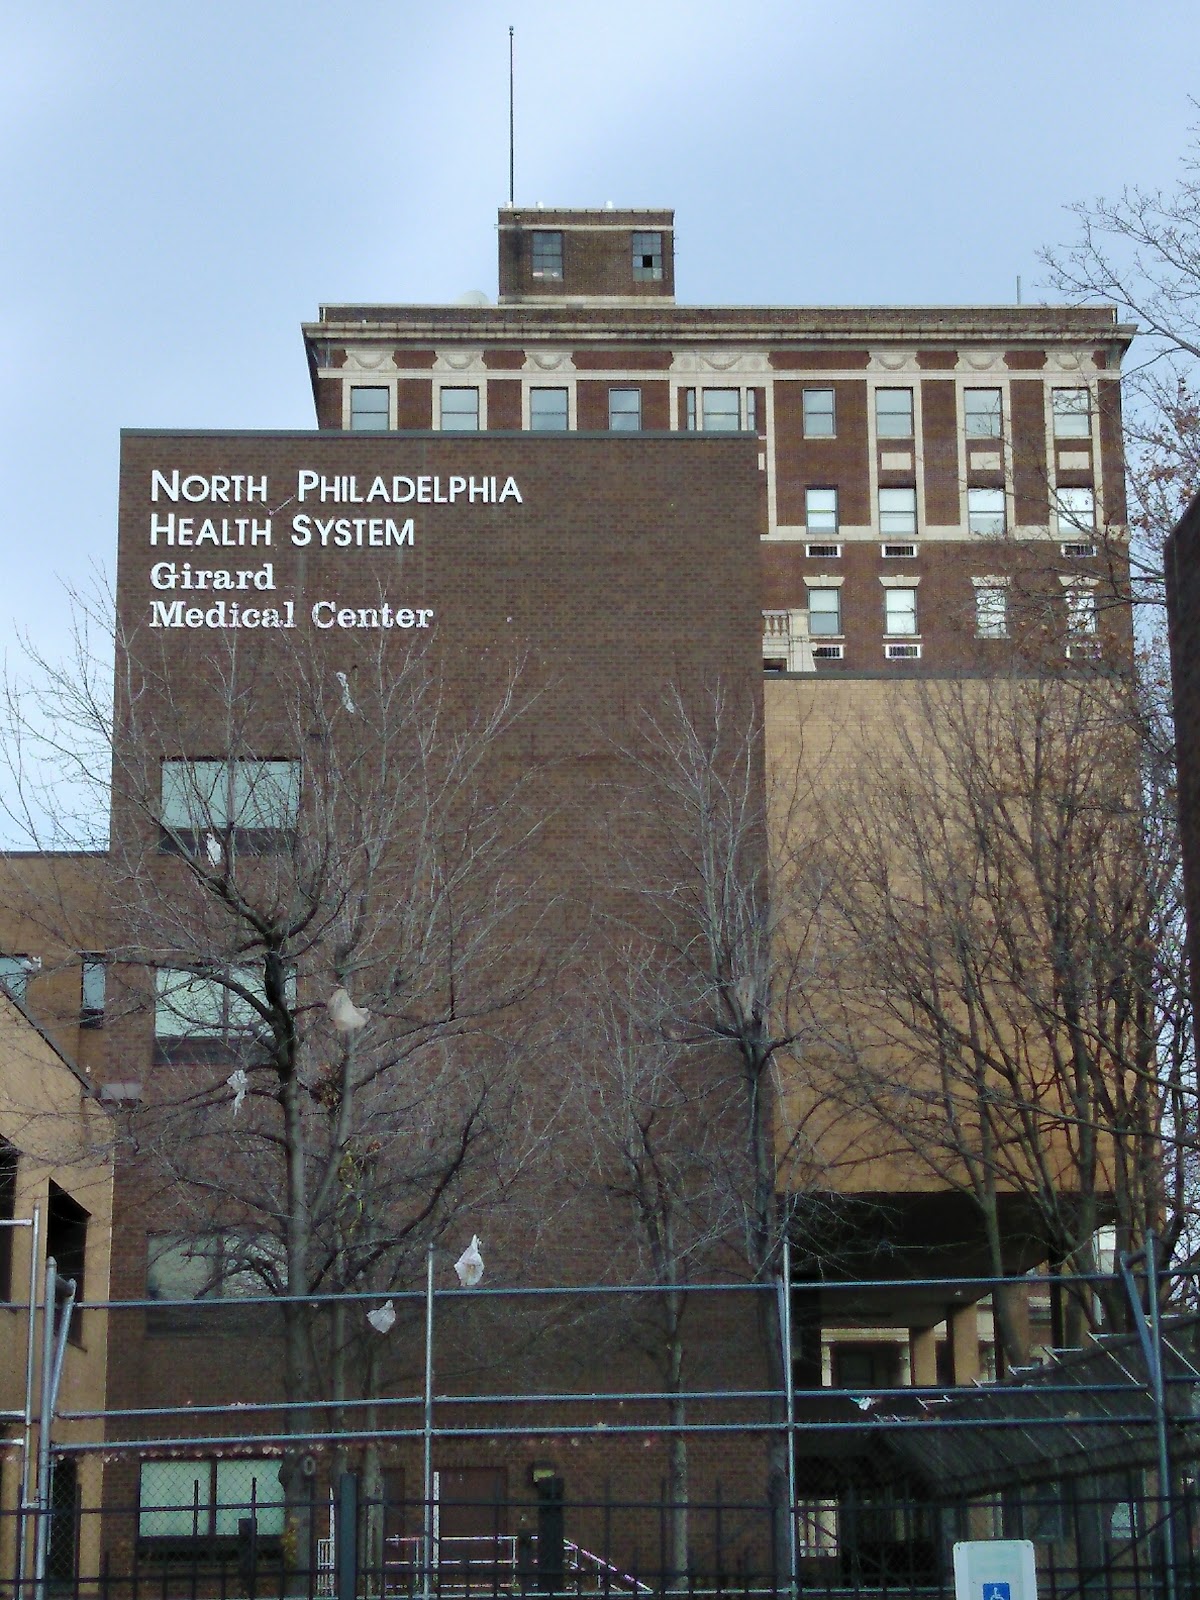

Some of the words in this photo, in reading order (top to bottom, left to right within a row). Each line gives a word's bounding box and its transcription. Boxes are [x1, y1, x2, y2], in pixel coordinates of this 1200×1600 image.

[151, 469, 268, 502] NORTH
[298, 470, 523, 503] PHILADELPHIA
[150, 512, 272, 546] HEALTH
[291, 514, 414, 546] SYSTEM
[150, 562, 277, 590] Girard
[149, 601, 297, 628] Medical
[311, 601, 434, 628] Center
